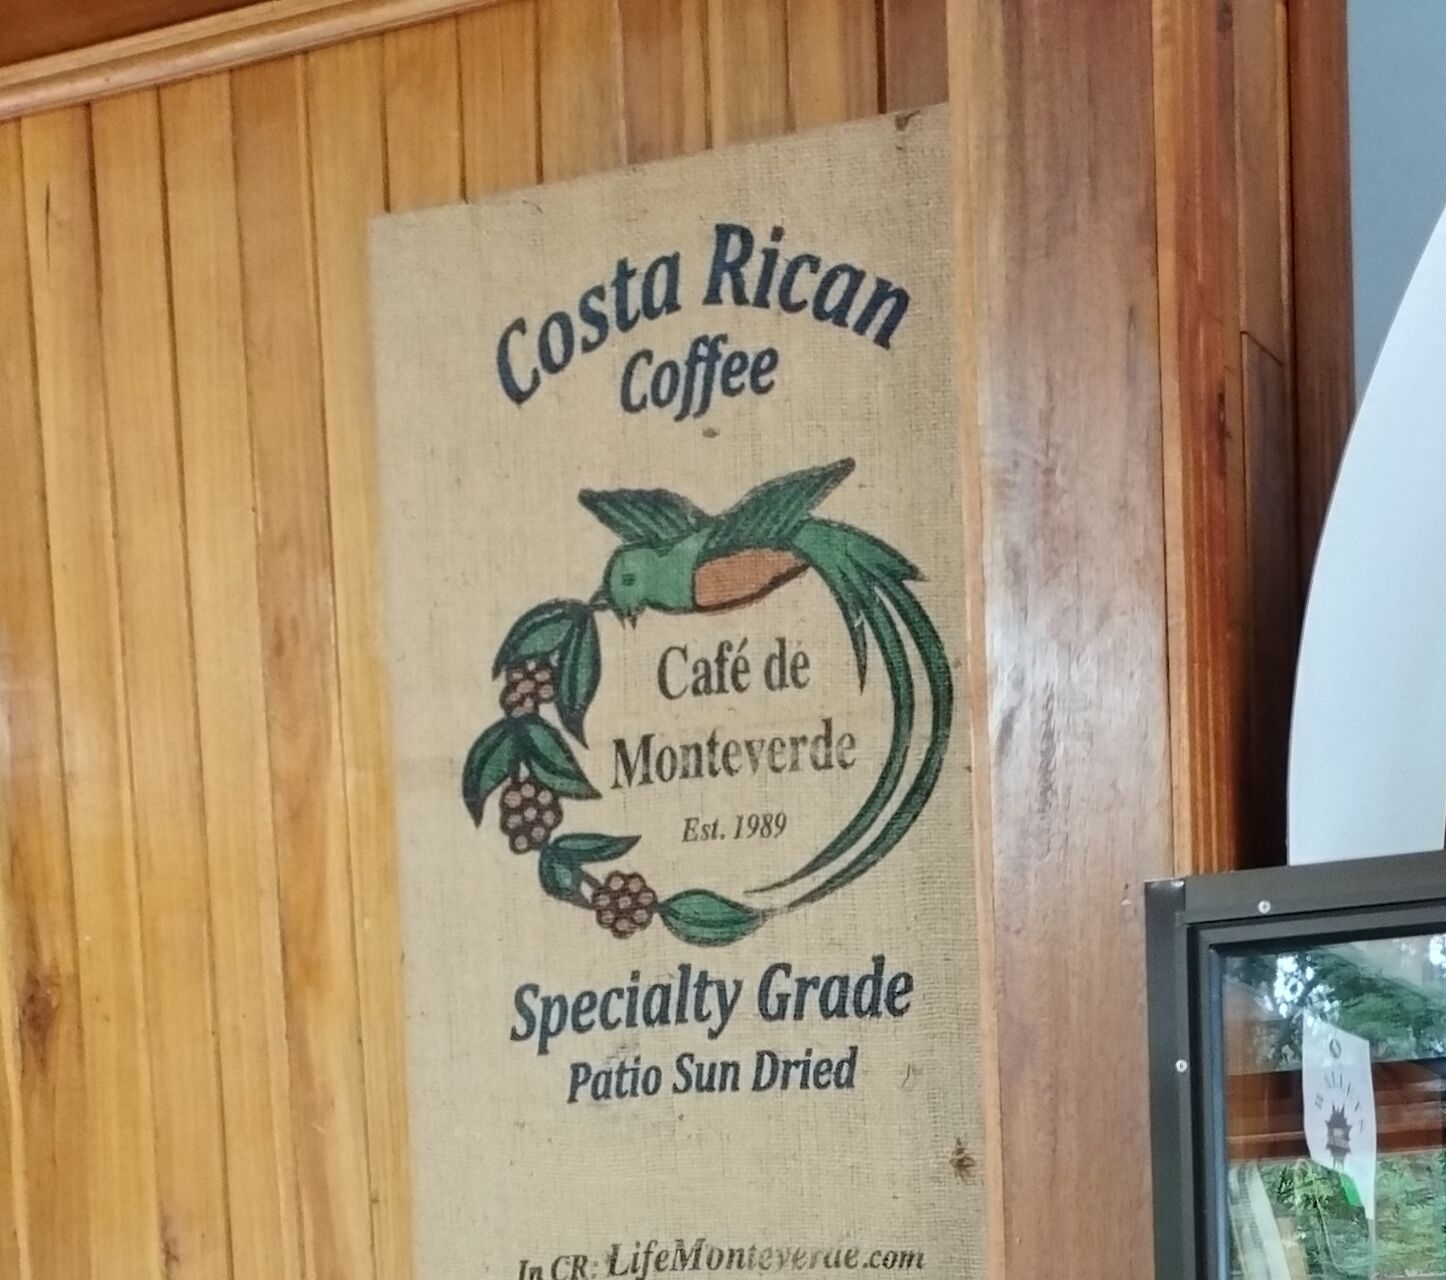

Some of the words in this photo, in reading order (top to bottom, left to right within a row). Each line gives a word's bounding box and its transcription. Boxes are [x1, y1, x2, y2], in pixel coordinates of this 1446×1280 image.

[496, 250, 681, 408] Costa
[703, 222, 910, 350] Rican
[620, 334, 779, 421] Coffee
[657, 637, 750, 700] Café
[764, 637, 811, 691] de
[610, 718, 857, 789] Monteverde
[682, 817, 725, 842] Est.
[735, 812, 787, 839] 1989
[510, 963, 743, 1055] Specialty
[757, 954, 915, 1021] Grade
[567, 1061, 662, 1104] Patio
[672, 1052, 740, 1094] Sun
[752, 1046, 858, 1092] Dried
